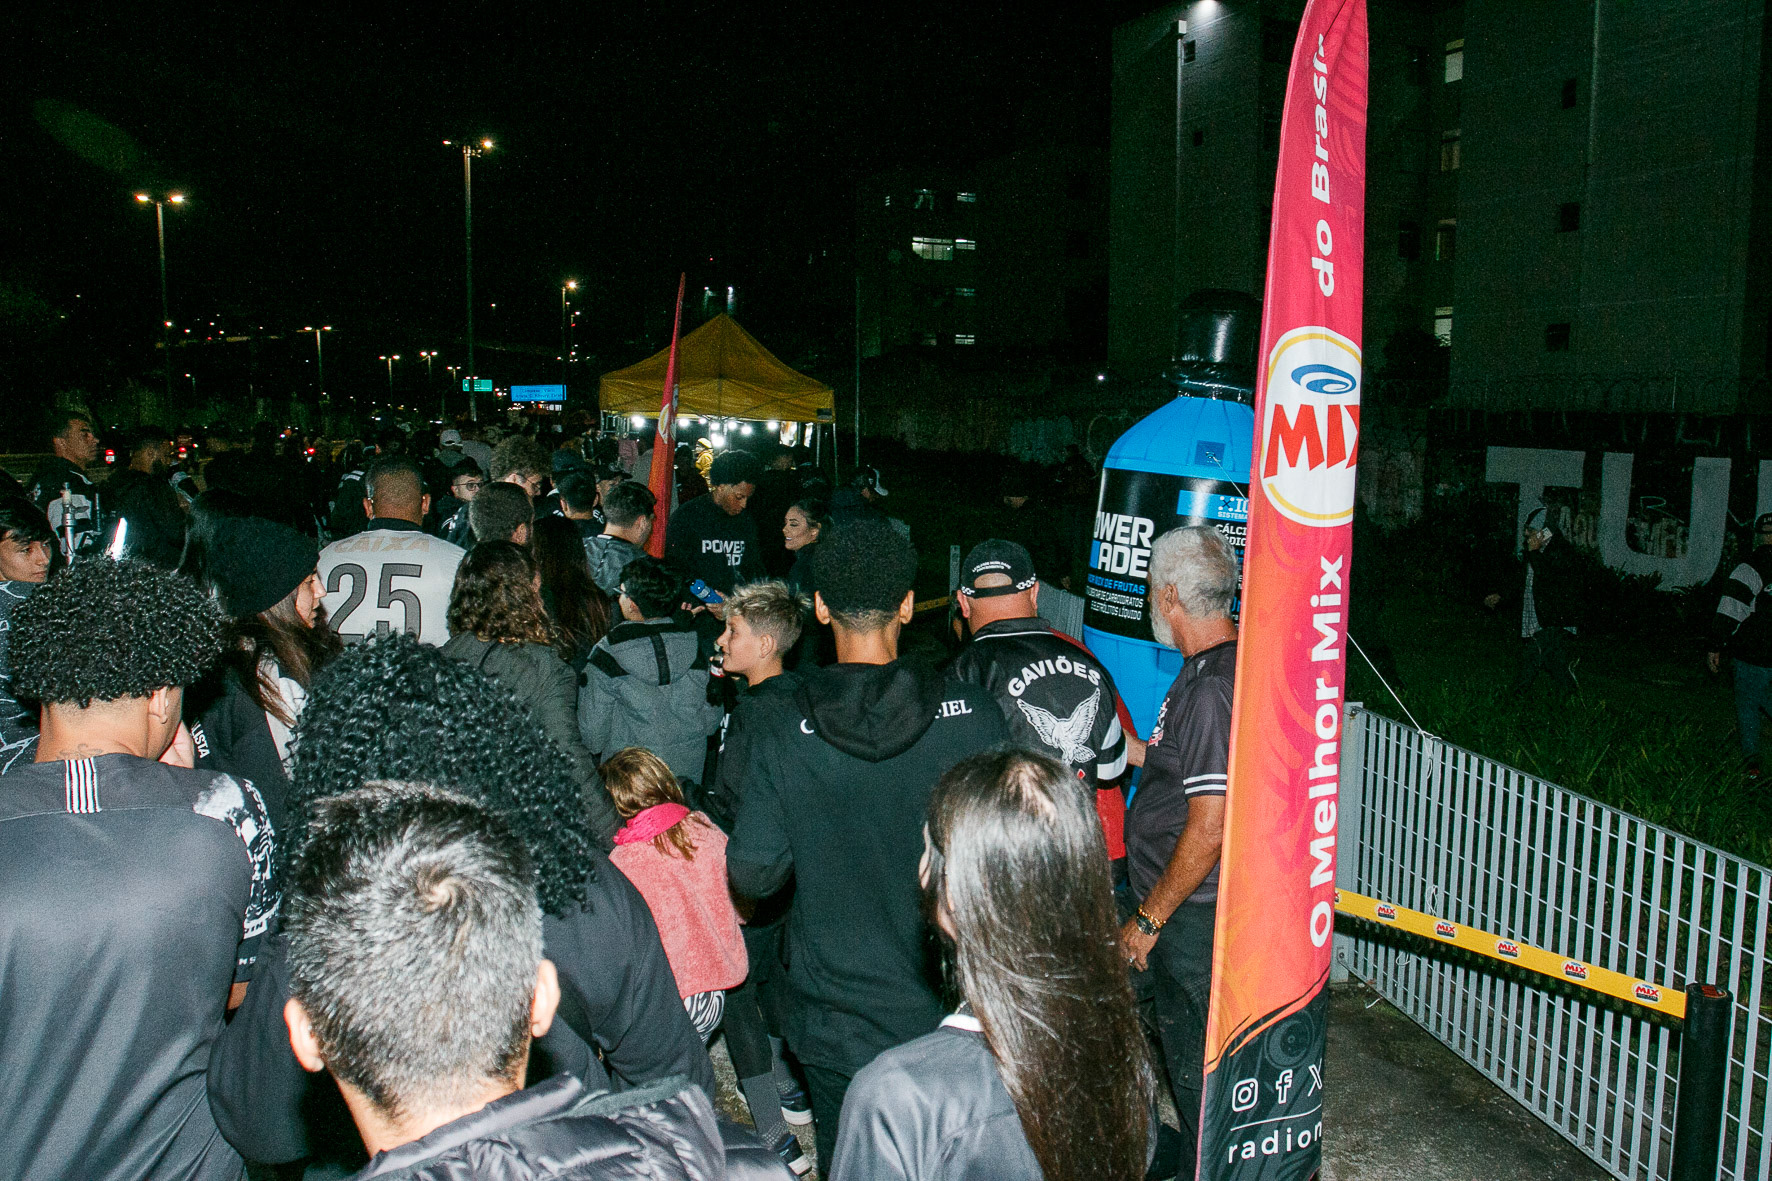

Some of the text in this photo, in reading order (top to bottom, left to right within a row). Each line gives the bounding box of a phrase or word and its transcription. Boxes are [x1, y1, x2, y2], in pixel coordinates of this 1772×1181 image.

[1311, 219, 1335, 298] do
[1093, 511, 1154, 548] OWER
[1215, 523, 1248, 536] CÁLCI
[333, 536, 430, 553] CAIXA
[1097, 541, 1151, 579] ADE
[1112, 579, 1146, 596] FRUTAS
[326, 562, 423, 646] 25
[1007, 655, 1101, 698] GAVIÕES
[934, 699, 973, 719] IEL
[190, 719, 211, 759] LISTA
[1307, 554, 1344, 949] O Melhor Mix
[1377, 906, 1396, 916] MIX
[1436, 923, 1456, 934] MIX
[1497, 942, 1518, 954] MIX
[1564, 963, 1587, 975] MIX
[1635, 985, 1660, 997] MIX
